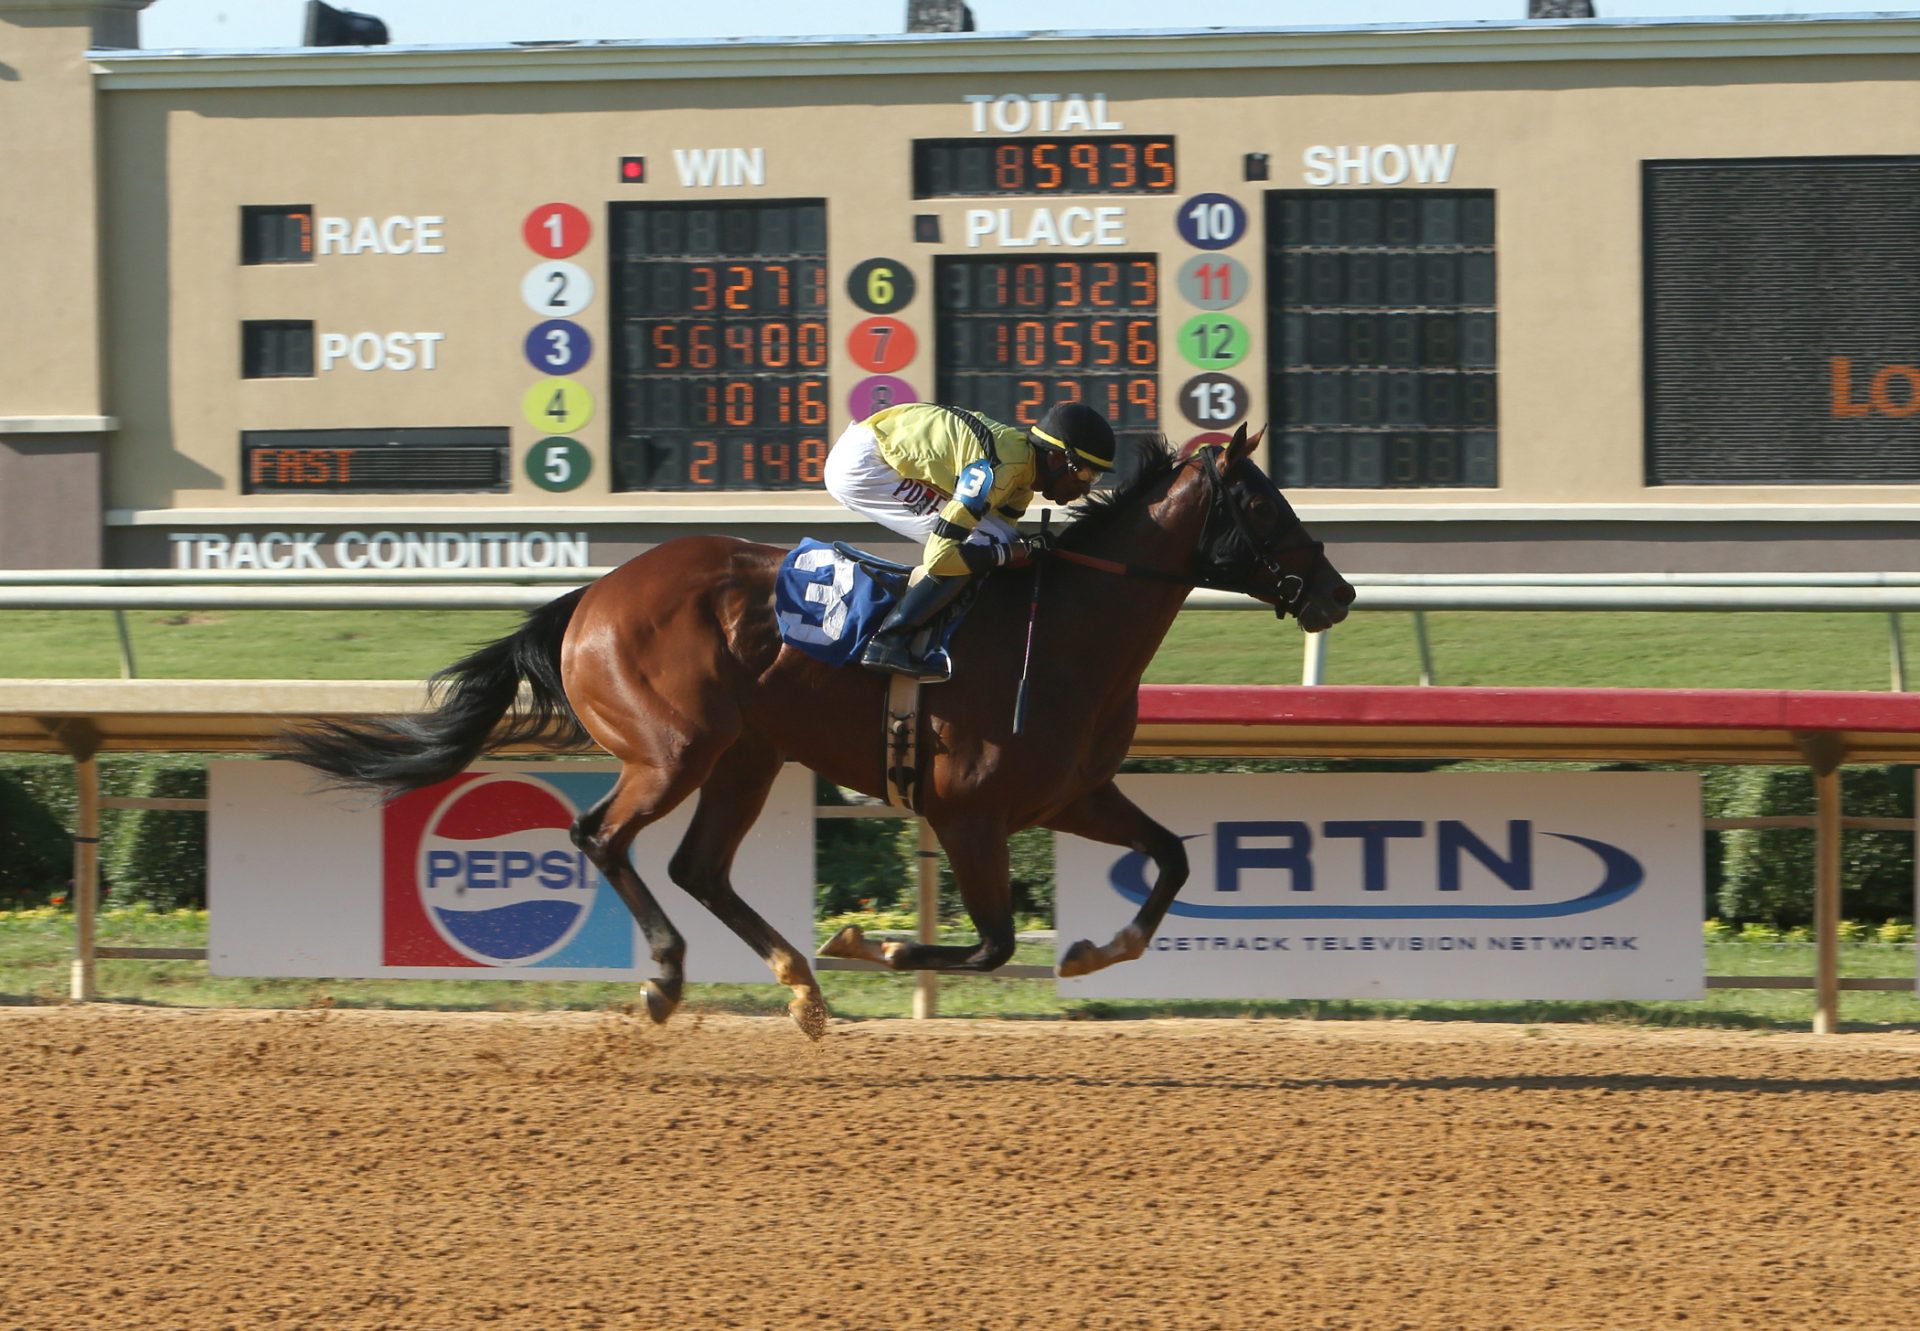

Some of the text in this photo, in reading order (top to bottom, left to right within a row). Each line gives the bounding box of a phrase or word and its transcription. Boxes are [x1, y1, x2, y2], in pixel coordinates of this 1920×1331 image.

[963, 93, 1123, 134] TOTAL
[674, 148, 765, 187] WIN
[996, 142, 1175, 189] 85935
[1303, 144, 1457, 186] SHOW
[287, 212, 312, 253] 7
[318, 215, 446, 255] RACE
[543, 214, 563, 248] 1
[965, 207, 1127, 247] PLACE
[1189, 203, 1235, 241] 10
[546, 271, 569, 307] 2
[691, 265, 826, 311] 3271
[867, 267, 894, 305] 6
[997, 261, 1157, 307] 10323
[1194, 263, 1232, 301] 11
[319, 332, 446, 372] POST
[545, 329, 571, 365] 3
[652, 322, 827, 369] 56400
[869, 326, 896, 363] 7
[997, 320, 1157, 366] 10556
[1191, 323, 1235, 360] 12
[544, 388, 570, 423] 4
[706, 380, 828, 426] 1016
[1190, 382, 1236, 420] 13
[251, 449, 355, 484] FAST
[544, 445, 571, 482] 5
[688, 439, 826, 485] 2148
[956, 467, 987, 498] 3
[168, 531, 591, 568] TRACK CONDITION
[778, 548, 856, 646] 3
[427, 850, 589, 889] PEPSI
[1214, 819, 1535, 892] RTN
[1147, 936, 1638, 951] CETRACK TELEVISION NETWORK
